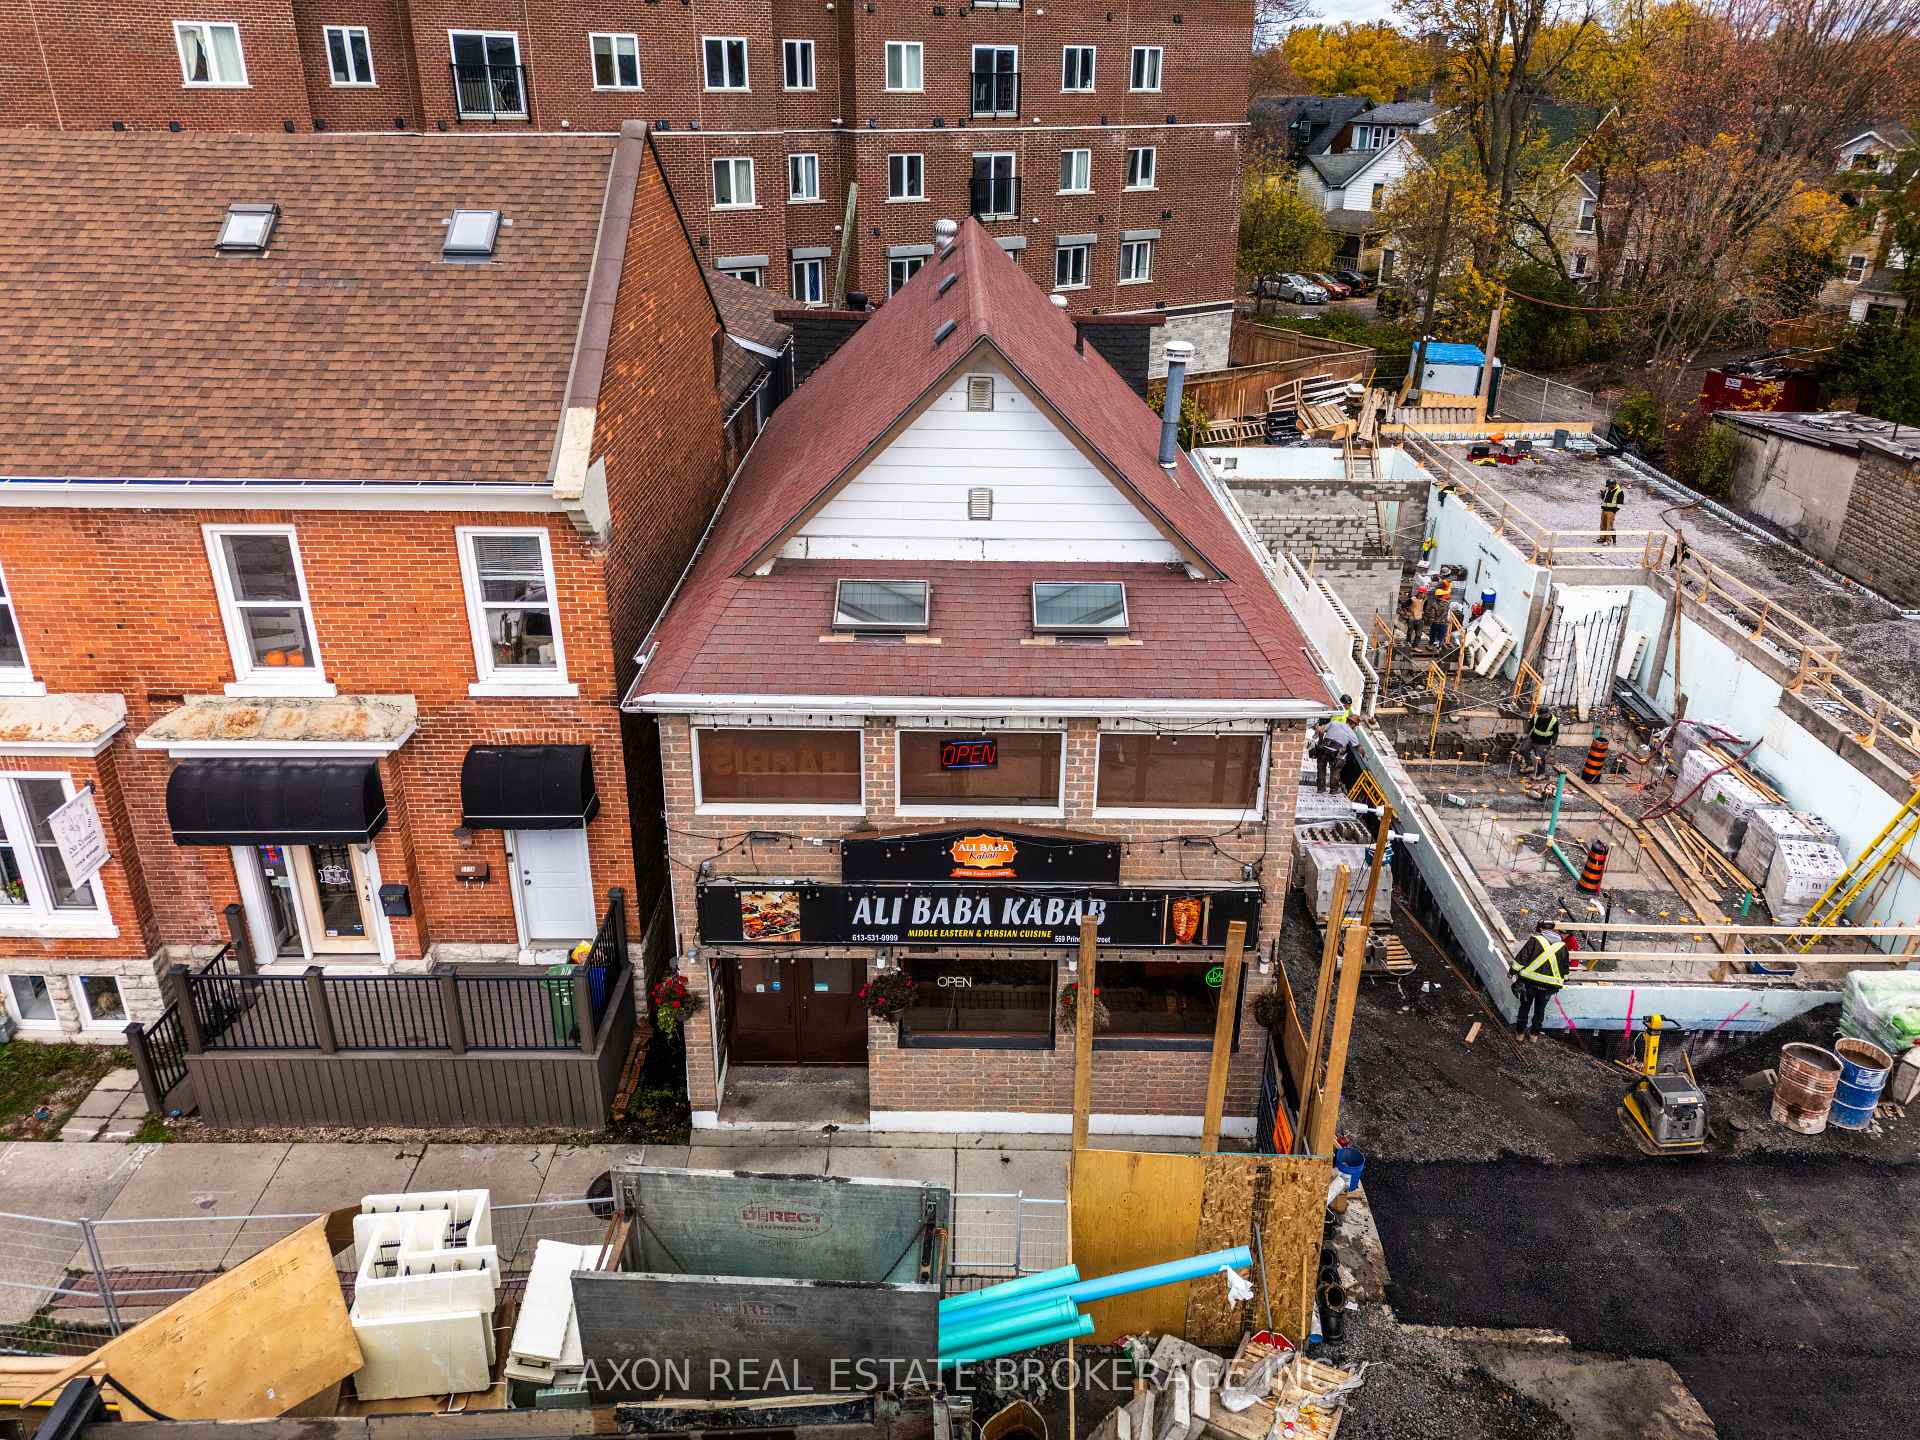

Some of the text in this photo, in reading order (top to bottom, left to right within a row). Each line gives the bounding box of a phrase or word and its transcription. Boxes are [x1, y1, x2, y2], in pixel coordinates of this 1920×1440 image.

[942, 745, 996, 764] OPEN
[958, 843, 1009, 852] ALI BABA
[851, 897, 1106, 926] ALI BABA KABAB
[852, 934, 898, 942] 613-531-9999
[907, 929, 1052, 938] MIDDLE EASTERN & PERSIAN CUISINE
[937, 976, 972, 988] OPEN
